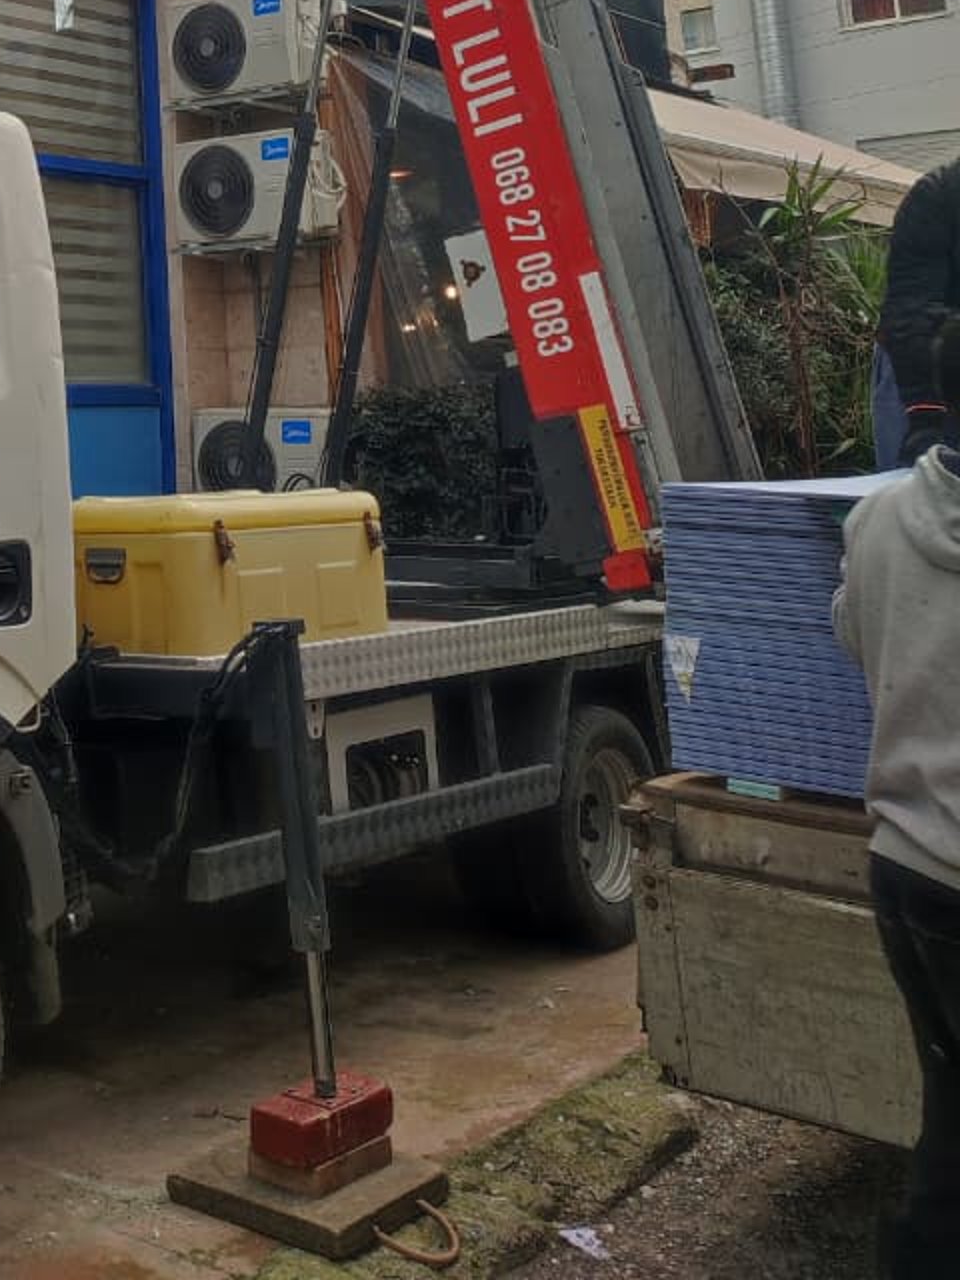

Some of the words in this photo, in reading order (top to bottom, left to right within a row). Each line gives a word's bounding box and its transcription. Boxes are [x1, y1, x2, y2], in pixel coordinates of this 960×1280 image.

[450, 26, 523, 138] LULI
[489, 147, 536, 213] 068
[505, 209, 546, 244] 27
[516, 251, 558, 294] 08
[527, 299, 574, 358] 083
